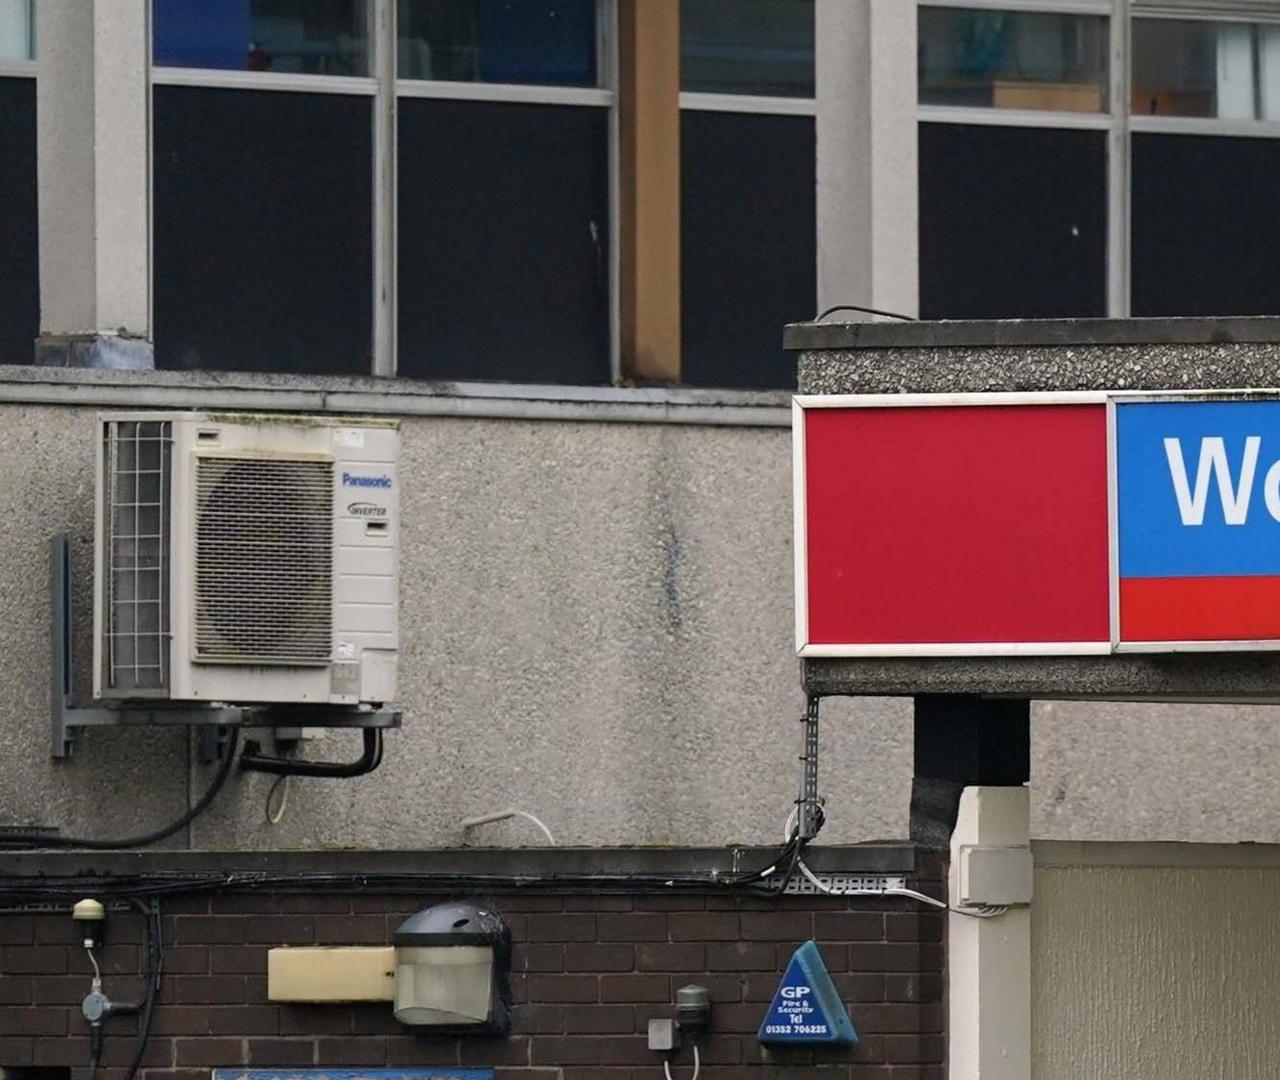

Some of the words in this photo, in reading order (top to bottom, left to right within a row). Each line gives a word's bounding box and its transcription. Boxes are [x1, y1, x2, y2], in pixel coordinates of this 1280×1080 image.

[342, 473, 392, 489] Panasonic
[780, 986, 811, 999] GP
[777, 1006, 814, 1014] Security
[789, 1014, 803, 1024] Tel
[766, 1025, 791, 1034] 01352
[794, 1025, 827, 1034] 706225
